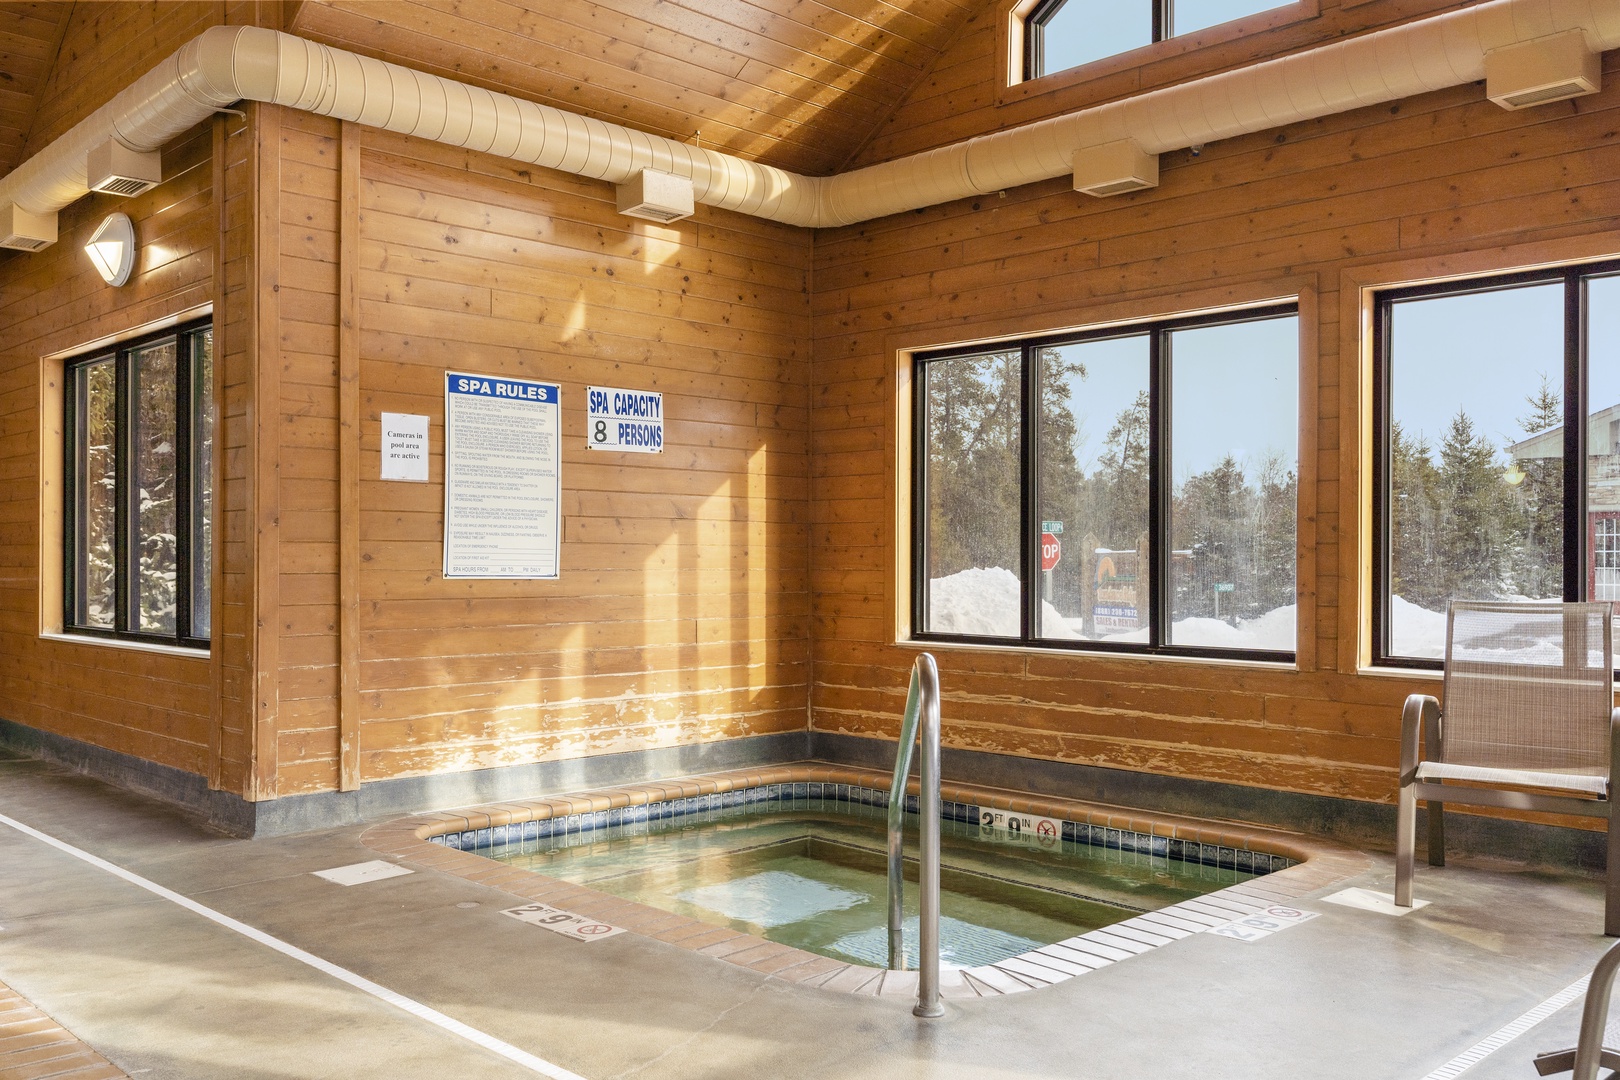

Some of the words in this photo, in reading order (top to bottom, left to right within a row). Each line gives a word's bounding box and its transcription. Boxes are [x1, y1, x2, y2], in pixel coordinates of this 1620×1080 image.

[458, 379, 491, 394] SPA
[496, 383, 547, 400] RULES
[590, 391, 609, 414] SPA
[614, 393, 660, 417] CAPACITY
[594, 420, 607, 442] 8
[618, 423, 661, 447] PERSONS
[1096, 617, 1112, 626] SALES
[982, 812, 994, 827] 2
[995, 814, 1003, 822] FT
[1022, 818, 1030, 828] IN
[508, 906, 544, 915] 2
[538, 915, 573, 924] 9
[1216, 929, 1256, 939] 2
[1242, 919, 1279, 929] 9
